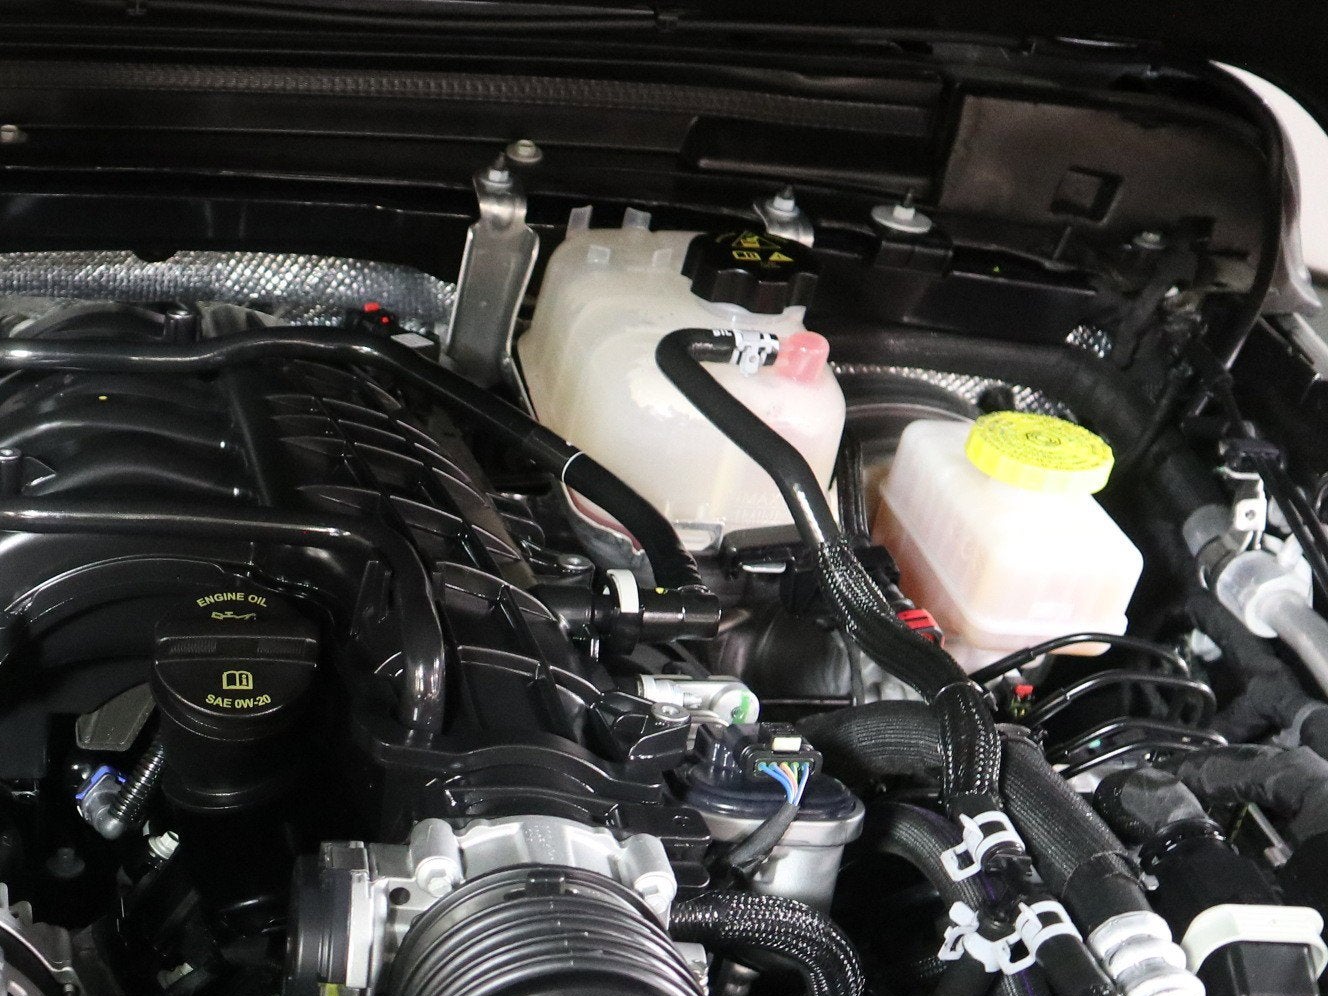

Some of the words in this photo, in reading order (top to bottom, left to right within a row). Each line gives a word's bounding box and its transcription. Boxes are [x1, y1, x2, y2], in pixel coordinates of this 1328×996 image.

[196, 592, 245, 608] ENGINE
[248, 594, 268, 607] OIL
[206, 694, 232, 708] SAE
[235, 694, 271, 708] 0W-20
